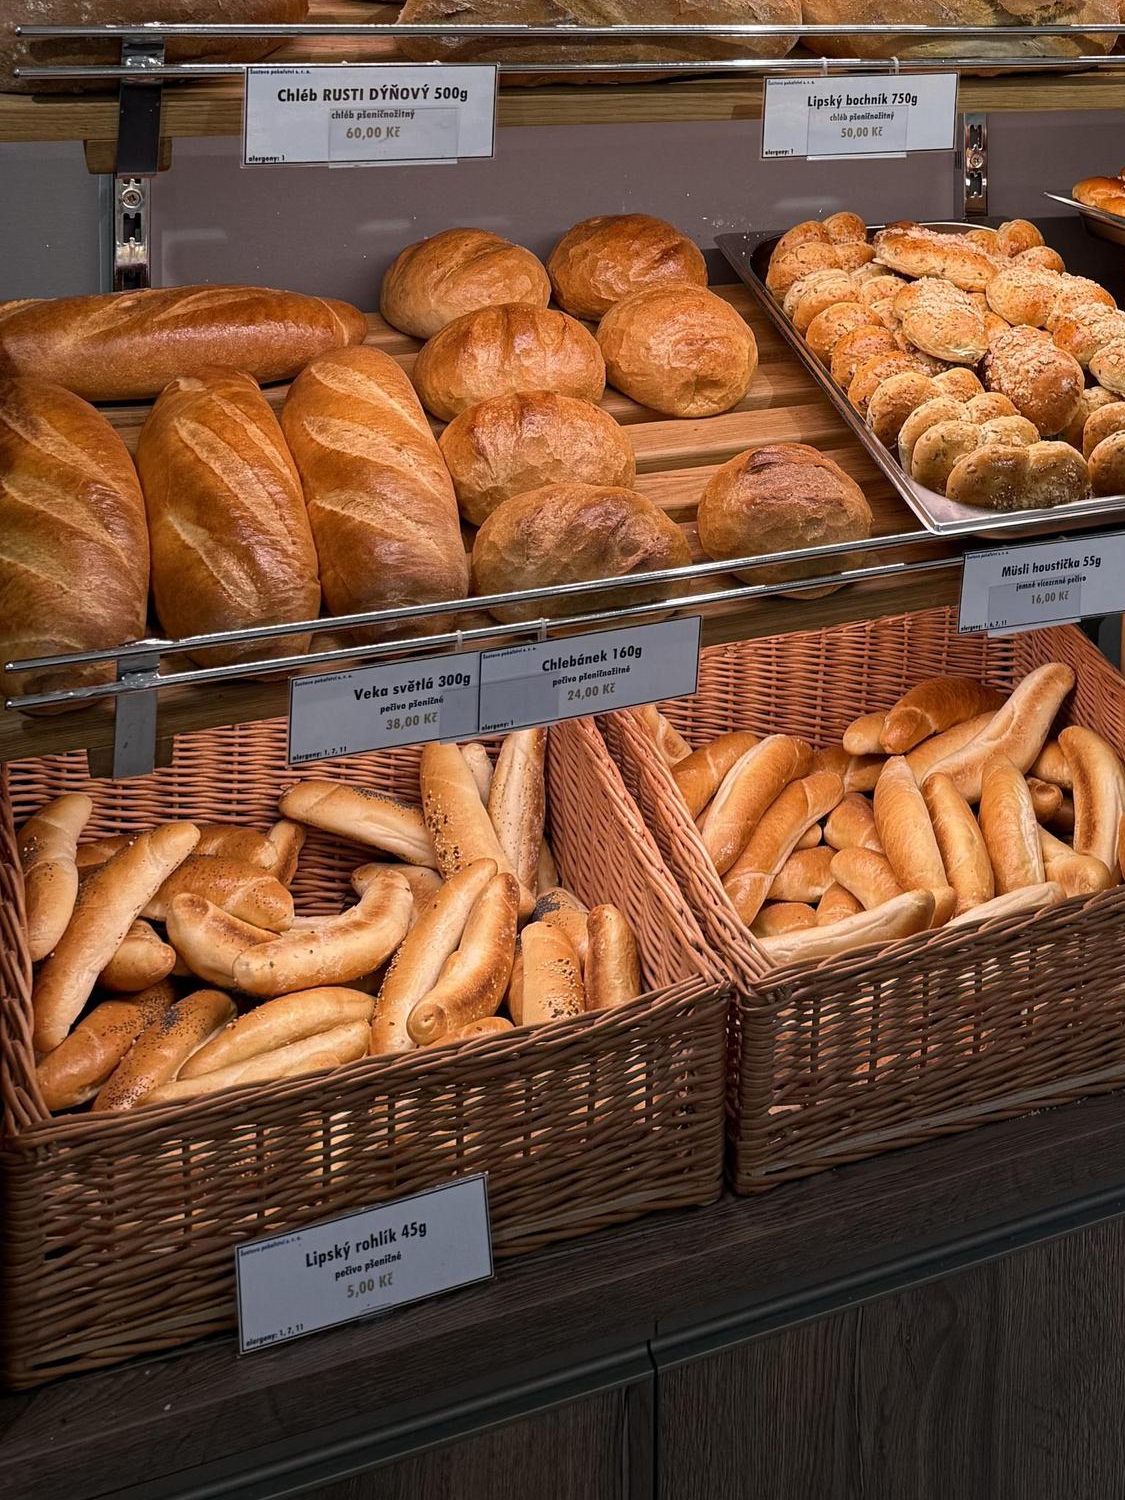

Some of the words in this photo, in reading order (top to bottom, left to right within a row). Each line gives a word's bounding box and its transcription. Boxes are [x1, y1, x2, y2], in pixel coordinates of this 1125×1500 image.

[277, 89, 317, 102] Chléb
[324, 88, 364, 101] RUSTI
[370, 84, 429, 100] DÝŇOVÝ
[434, 87, 468, 102] 500g
[808, 95, 842, 109] Lipský
[846, 94, 888, 106] bochník
[891, 93, 918, 106] 750g
[331, 110, 354, 120] chléb
[357, 110, 415, 121] pšeničnožitný
[830, 113, 847, 122] chléb
[346, 127, 382, 139] 60,00
[386, 126, 400, 138] Kč
[841, 127, 869, 139] 50,00
[872, 127, 883, 137] Kč
[1002, 563, 1029, 577] Müsli
[1033, 556, 1079, 573] houstička
[1082, 556, 1101, 568] 55g
[1016, 582, 1035, 592] jemné
[1067, 575, 1086, 585] pečivo
[1031, 592, 1056, 605] 16,00
[1058, 591, 1069, 600] Kč
[542, 651, 608, 672] Chlebánek
[613, 645, 642, 659] 160g
[552, 674, 577, 688] pečivo
[579, 665, 630, 682] pšeničnožitné
[354, 686, 388, 700] Veka
[393, 679, 433, 695] světlá
[438, 673, 471, 687] 300g
[568, 685, 599, 701] 24,00
[602, 682, 616, 695] Kč
[380, 701, 406, 714] pečivo
[408, 696, 444, 710] pšeničné
[386, 714, 420, 730] 38,00
[424, 712, 438, 724] Kč
[293, 751, 323, 761] alergeny:
[305, 1242, 351, 1268] Lipský
[356, 1228, 397, 1253] rohlík
[401, 1222, 427, 1238] 45g
[335, 1263, 362, 1281] pečivo
[365, 1251, 402, 1271] pšeničné
[347, 1279, 375, 1299] 5,00
[379, 1272, 394, 1287] Kč
[246, 1332, 278, 1347] alergeny:
[296, 1324, 304, 1333] 11
